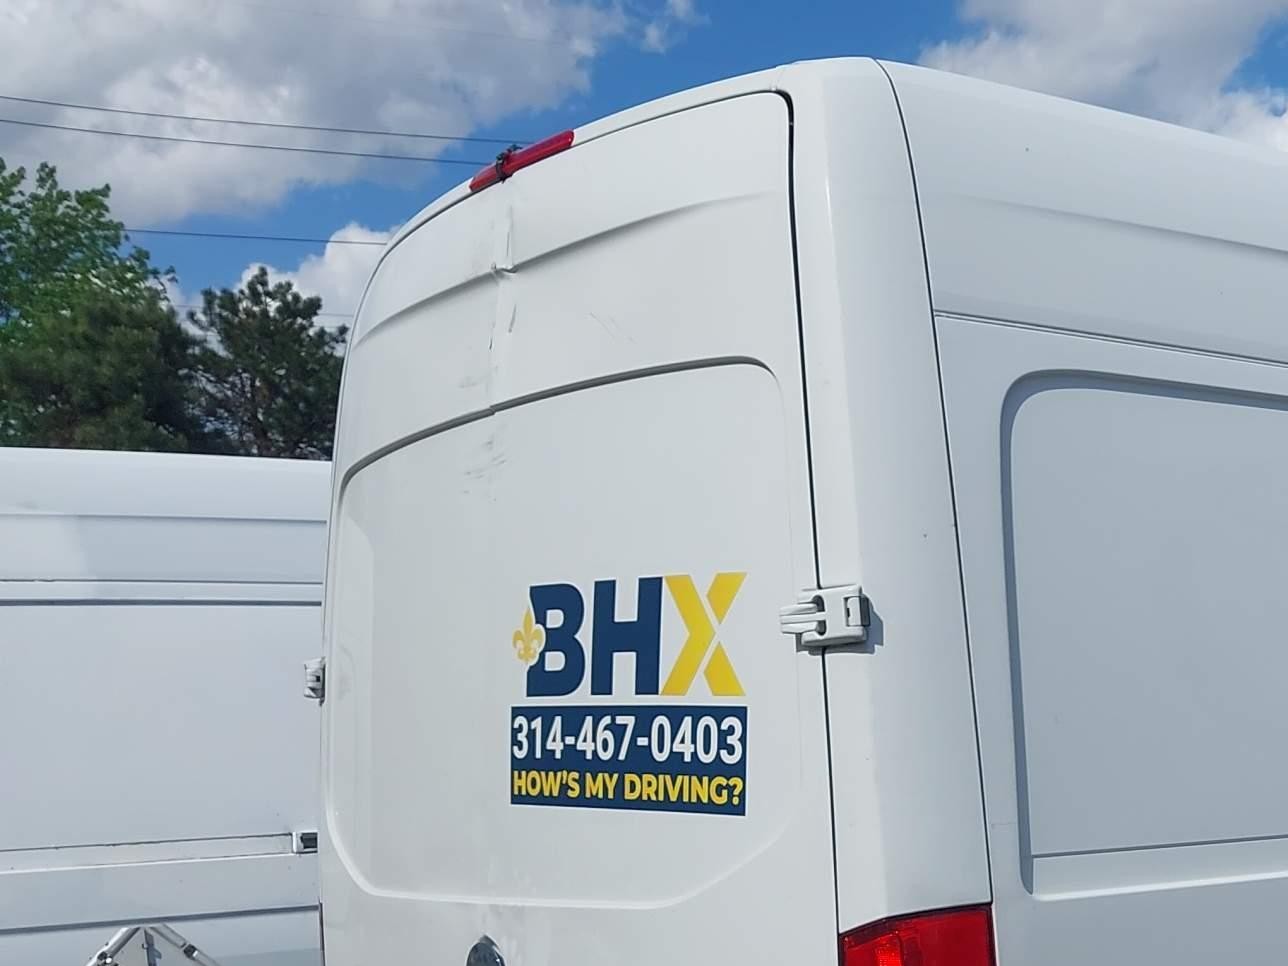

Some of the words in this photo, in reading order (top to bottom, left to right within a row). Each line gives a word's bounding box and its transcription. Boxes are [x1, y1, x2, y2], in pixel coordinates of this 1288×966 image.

[525, 572, 748, 698] BHX
[512, 715, 743, 765] 314-467-0403
[512, 770, 580, 798] HOW'S
[585, 772, 619, 799] MY
[623, 773, 744, 806] DRIVING?
